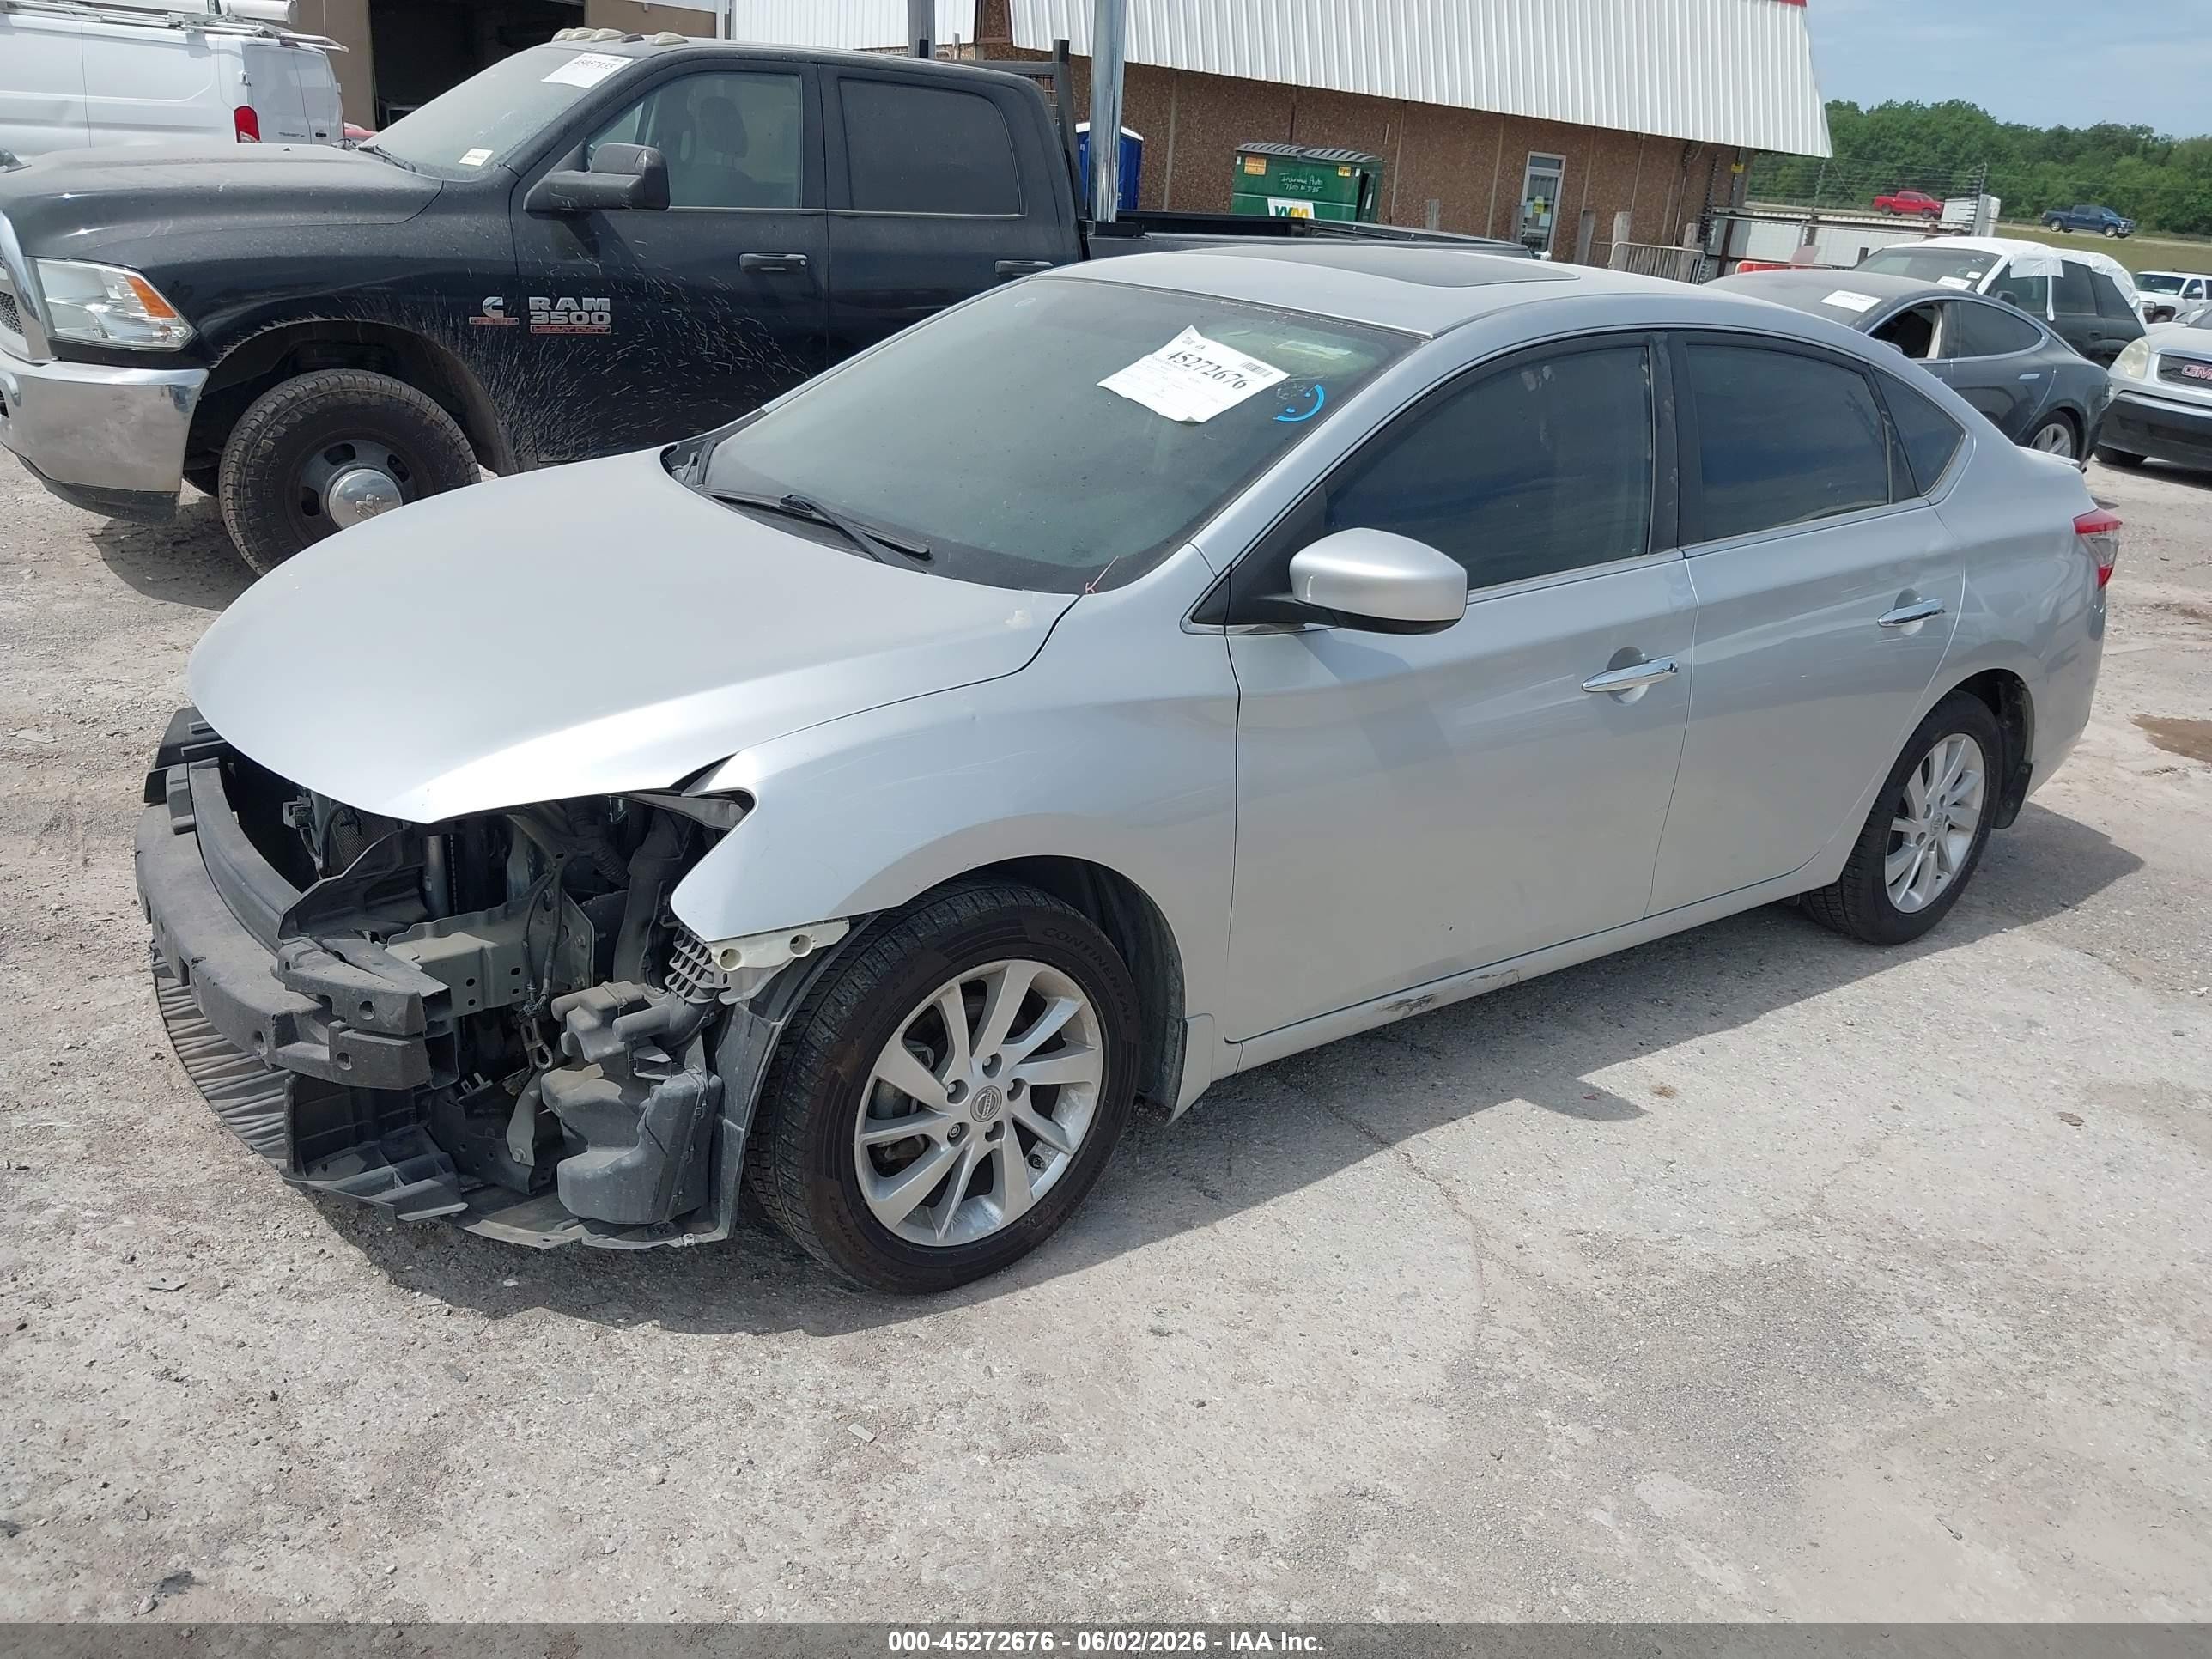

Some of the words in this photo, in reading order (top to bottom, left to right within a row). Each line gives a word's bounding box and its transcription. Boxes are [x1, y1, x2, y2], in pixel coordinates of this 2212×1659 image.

[1274, 205, 1310, 217] WM
[529, 296, 611, 312] RAM
[530, 311, 611, 325] 3500
[1165, 350, 1253, 390] 45272676
